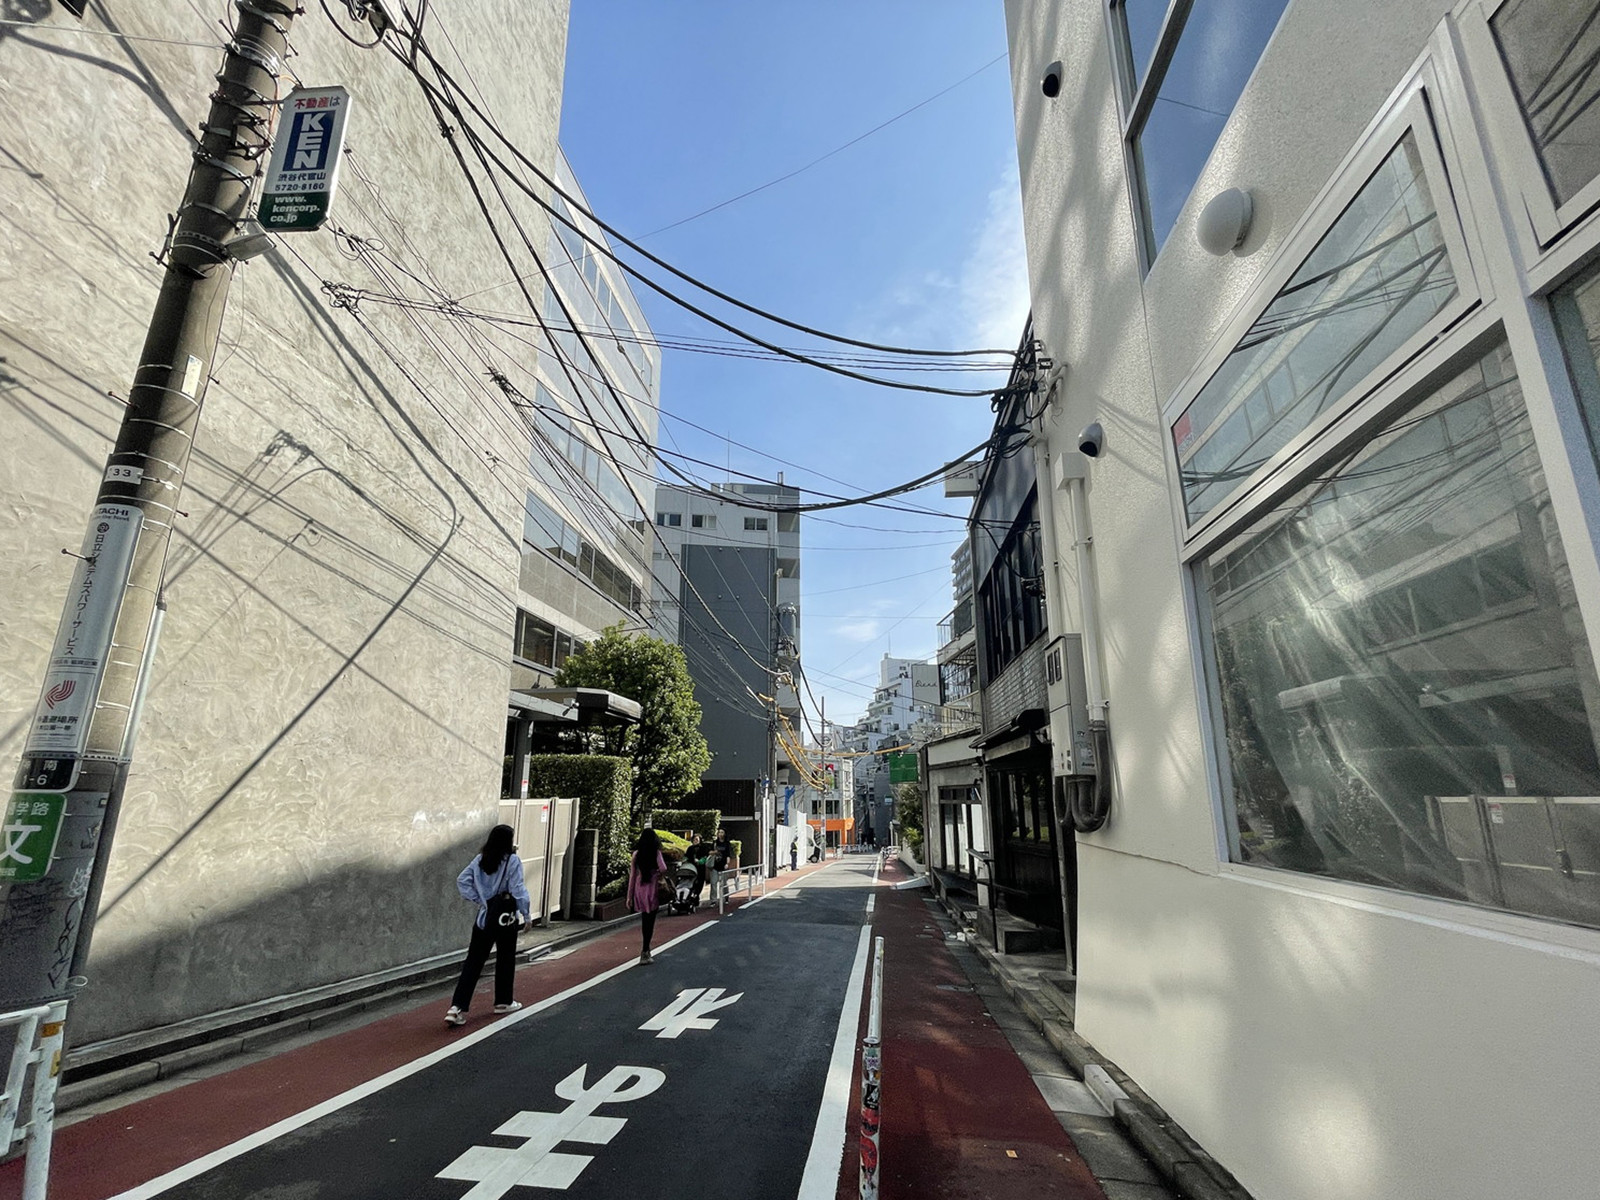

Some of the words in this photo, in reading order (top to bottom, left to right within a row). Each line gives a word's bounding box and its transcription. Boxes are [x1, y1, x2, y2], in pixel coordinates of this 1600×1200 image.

[294, 96, 341, 109] 不動産は
[292, 112, 324, 170] KEN
[278, 172, 326, 182] 渋谷代官山
[274, 196, 307, 204] www.
[272, 204, 321, 213] kencorp.
[270, 213, 298, 223] co.jp
[112, 468, 132, 477] 33
[23, 774, 48, 786] 1-6
[0, 819, 42, 864] 文
